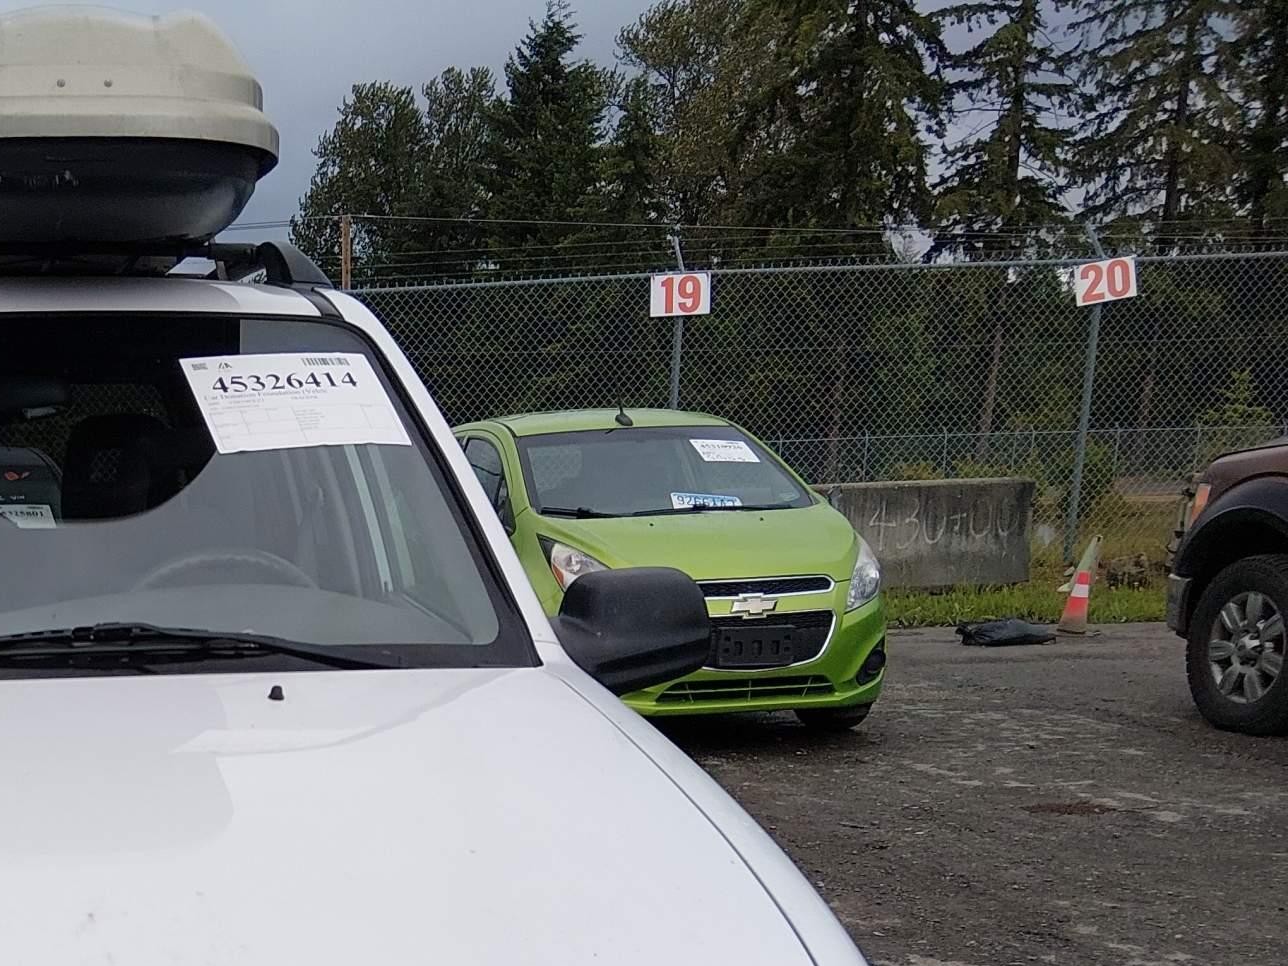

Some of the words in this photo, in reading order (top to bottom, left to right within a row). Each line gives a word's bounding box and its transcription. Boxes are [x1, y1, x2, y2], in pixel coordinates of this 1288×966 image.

[657, 275, 701, 315] 19
[1080, 260, 1130, 303] 20
[213, 372, 357, 393] 45326414
